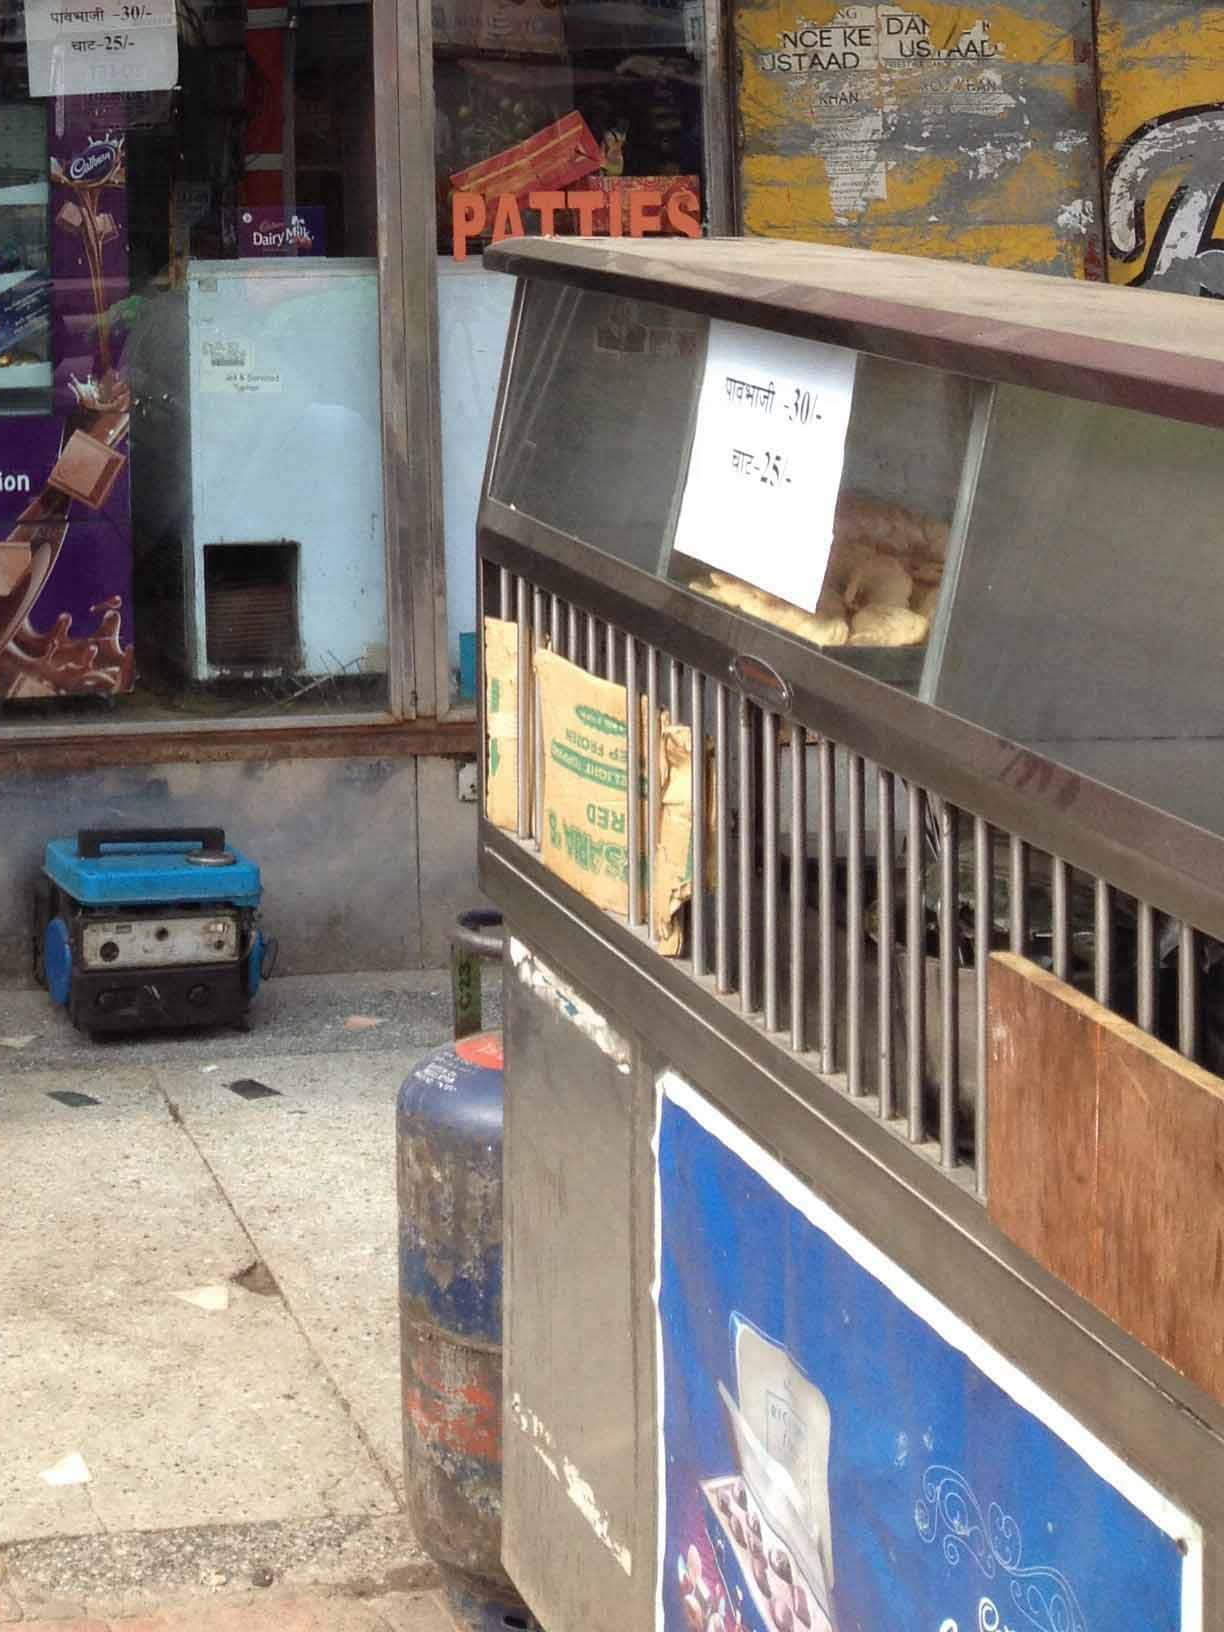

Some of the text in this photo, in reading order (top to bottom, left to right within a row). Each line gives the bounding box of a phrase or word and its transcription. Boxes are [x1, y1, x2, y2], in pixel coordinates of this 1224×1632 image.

[842, 28, 872, 48] KE
[452, 188, 702, 263] PATTIES
[253, 230, 285, 247] Dairy
